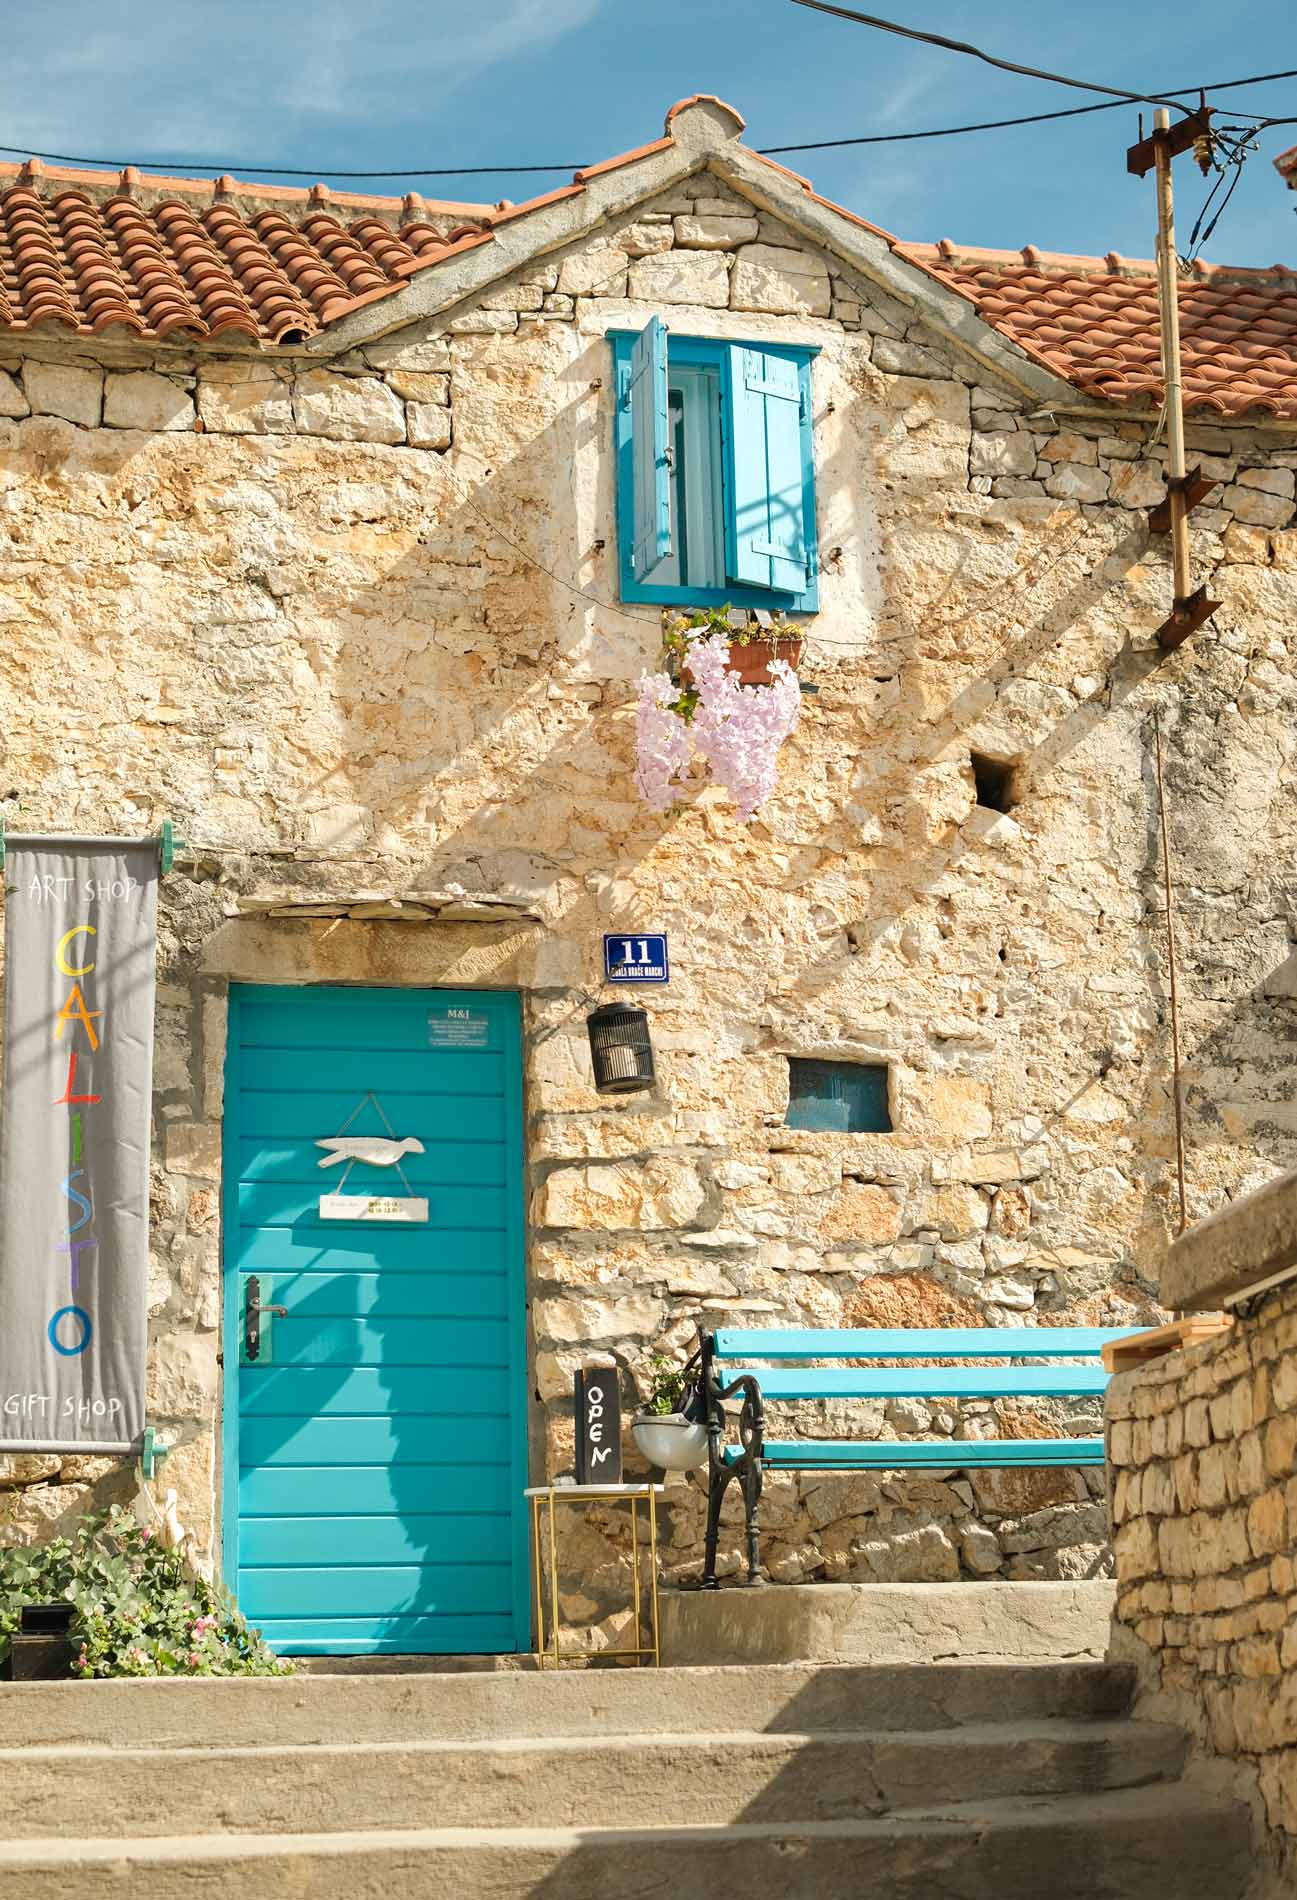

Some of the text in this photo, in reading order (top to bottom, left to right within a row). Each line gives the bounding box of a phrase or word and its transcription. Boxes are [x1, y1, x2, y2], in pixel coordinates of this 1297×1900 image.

[29, 874, 137, 904] ART SHOP
[621, 940, 652, 964] 11
[48, 925, 105, 1357] CALISTO
[4, 1393, 121, 1424] GIFT SHOP
[588, 1386, 612, 1468] OPEN
